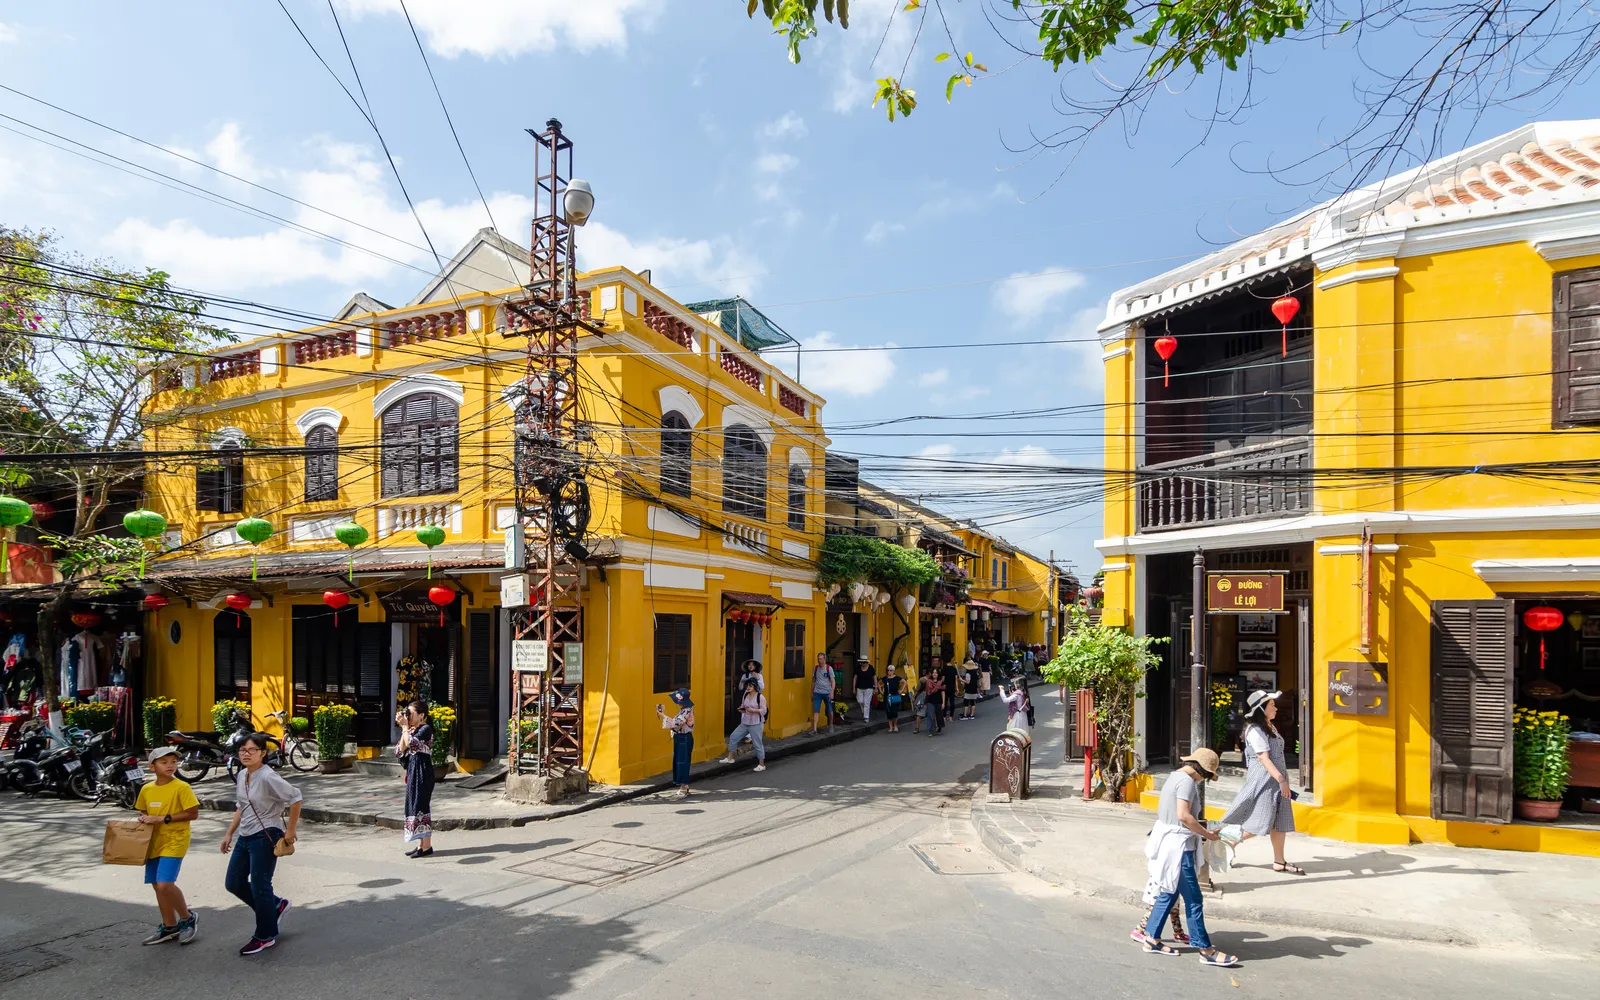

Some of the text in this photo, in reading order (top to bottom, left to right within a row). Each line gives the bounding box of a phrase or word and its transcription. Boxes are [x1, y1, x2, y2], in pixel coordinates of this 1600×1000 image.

[1238, 579, 1263, 590] ĐƯỜNG
[1234, 594, 1257, 607] LÊ LỢI
[388, 602, 438, 614] Tú Quyên
